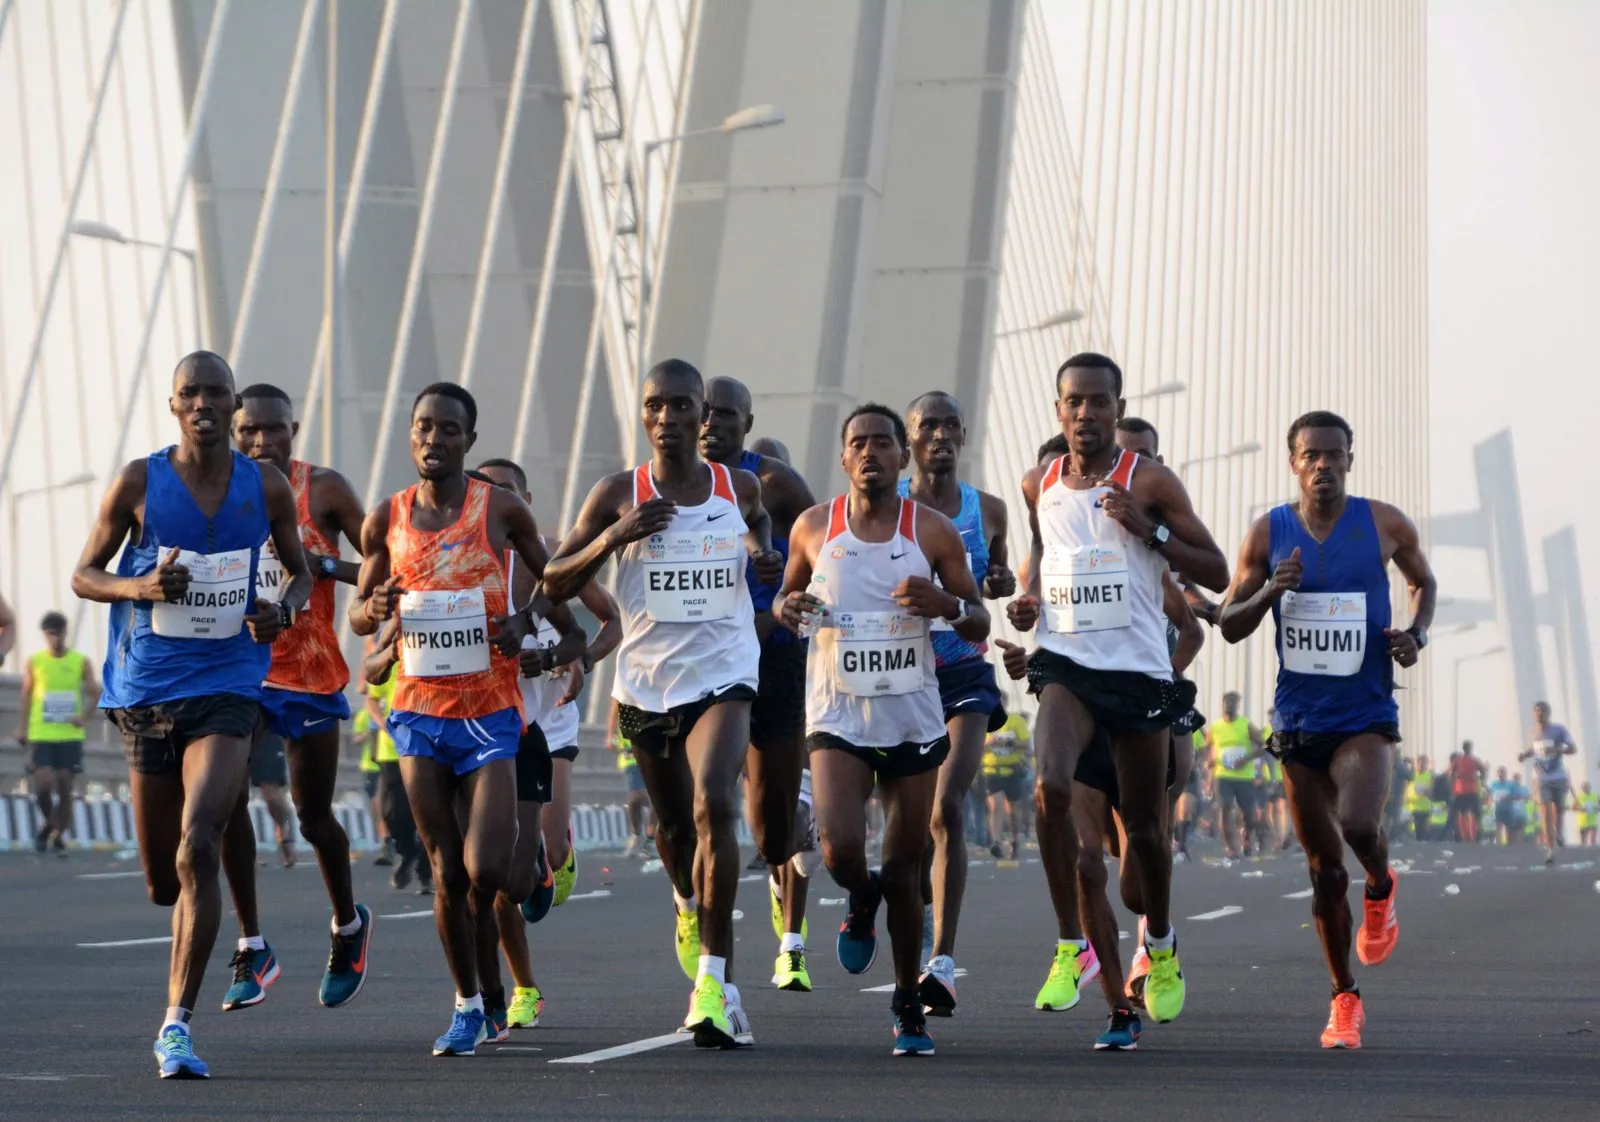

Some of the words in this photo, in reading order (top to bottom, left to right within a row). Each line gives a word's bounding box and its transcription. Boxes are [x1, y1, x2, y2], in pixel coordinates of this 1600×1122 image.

[649, 567, 734, 592] EZEKIEL
[683, 598, 707, 606] PACER
[1049, 583, 1124, 606] SHUMET
[190, 616, 217, 624] PACER
[403, 627, 485, 650] KIPKORIR
[1285, 626, 1361, 653] SHUMI
[843, 647, 916, 673] GIRMA
